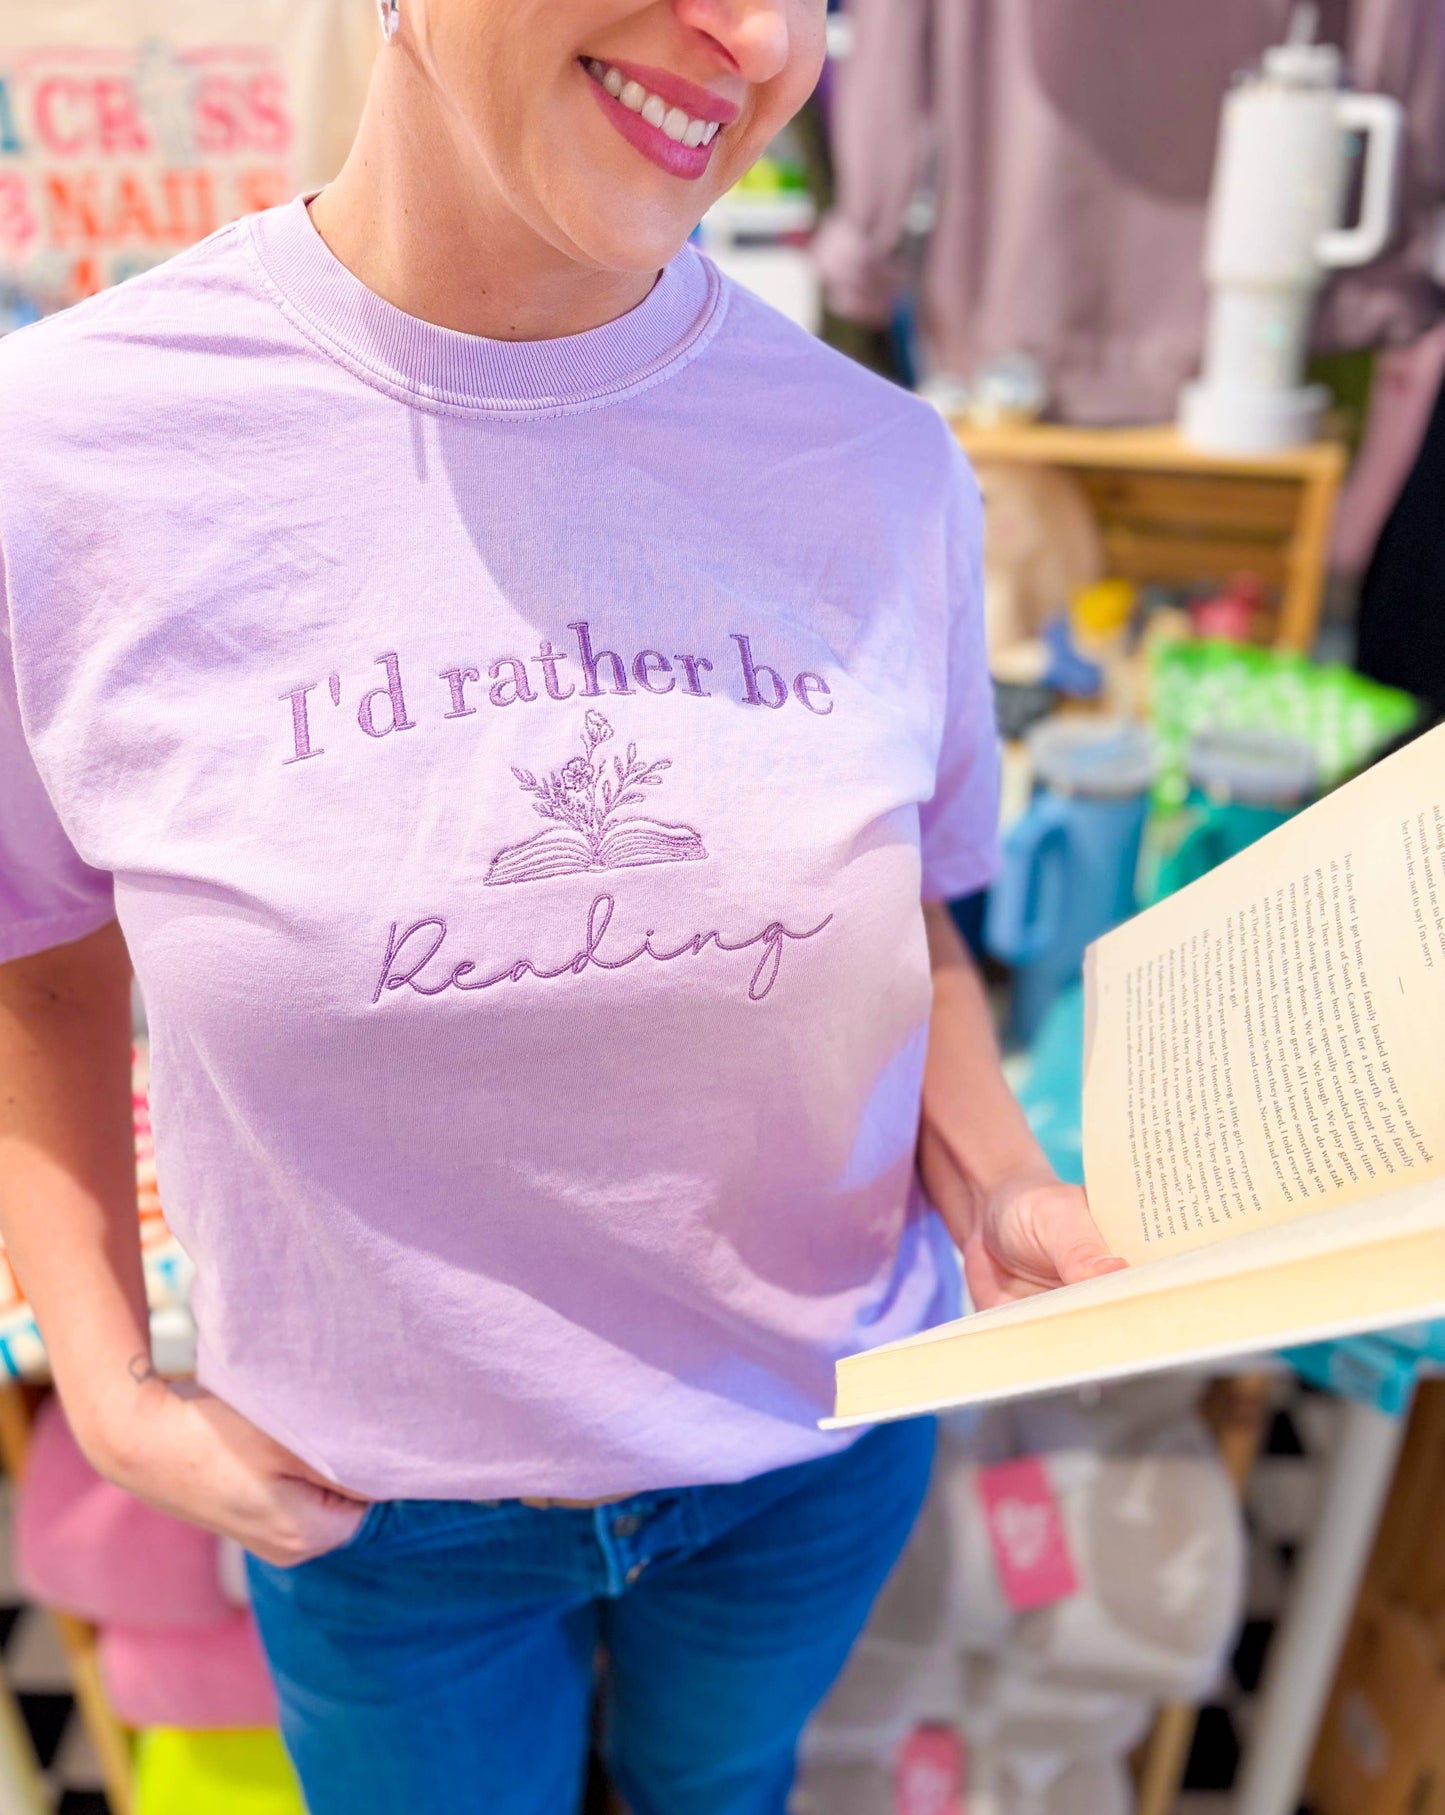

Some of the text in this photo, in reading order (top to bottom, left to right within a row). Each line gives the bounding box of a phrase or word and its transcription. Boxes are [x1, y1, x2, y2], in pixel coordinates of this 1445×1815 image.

[278, 621, 834, 765] I'd rather be
[1432, 804, 1443, 821] and
[1407, 860, 1415, 880] her,
[1410, 880, 1419, 897] not
[1430, 890, 1437, 906] me
[1412, 895, 1420, 908] to
[1433, 905, 1440, 918] to
[1414, 908, 1422, 924] say
[1435, 917, 1444, 932] be
[1418, 923, 1427, 941] I'm
[371, 893, 834, 1003] Reading
[1340, 950, 1349, 961] of
[1354, 939, 1364, 970] home,
[1422, 942, 1433, 969] sorry.
[1281, 976, 1290, 996] year
[1312, 970, 1323, 1002] family
[1328, 973, 1336, 997] have
[1342, 961, 1354, 991] South
[1359, 971, 1368, 988] our
[1258, 1001, 1266, 1020] this
[1285, 996, 1296, 1025] wasn't
[1296, 983, 1308, 1018] phones.
[1332, 996, 1341, 1021] been
[1347, 990, 1361, 1035] Carolina
[1363, 989, 1377, 1023] family
[1271, 993, 1281, 1035] Everyone
[1316, 1001, 1325, 1027] time,
[1259, 1019, 1267, 1039] way.
[1289, 1024, 1296, 1037] so
[1304, 1020, 1314, 1036] We
[1337, 1023, 1346, 1033] at
[1262, 1038, 1270, 1052] So
[1277, 1035, 1284, 1046] in
[1289, 1037, 1302, 1063] great.
[1307, 1036, 1319, 1060] talk.
[1321, 1027, 1338, 1074] especially
[1339, 1034, 1352, 1058] least
[1357, 1035, 1366, 1051] for
[1371, 1023, 1389, 1058] loaded
[1264, 1052, 1274, 1078] when
[1278, 1047, 1286, 1064] my
[1312, 1058, 1322, 1077] We
[1382, 1060, 1392, 1075] up
[1281, 1062, 1293, 1095] family
[1296, 1062, 1307, 1080] All
[1346, 1059, 1358, 1086] forty
[1365, 1062, 1384, 1098] Fourth
[1224, 1067, 1233, 1100] having
[1269, 1077, 1278, 1100] they
[1316, 1077, 1331, 1107] laugh.
[1387, 1076, 1399, 1095] our
[1243, 1004, 1292, 1203] supportive and curious. No one had ever seen
[1288, 1094, 1299, 1122] knew
[1302, 1087, 1319, 1122] wanted
[1332, 1074, 1354, 1119] extended
[1377, 1100, 1389, 1112] of
[1396, 1098, 1409, 1117] van
[1230, 1106, 1240, 1128] little
[1273, 1098, 1286, 1128] asked,
[1326, 1110, 1337, 1127] We
[1354, 1087, 1377, 1131] different
[1312, 1123, 1320, 1134] to
[1347, 1120, 1364, 1153] family
[1381, 1114, 1396, 1136] July
[1405, 1119, 1421, 1139] and
[1232, 1129, 1244, 1148] girl,
[1282, 1135, 1295, 1155] told
[1295, 1123, 1317, 1175] something
[1316, 1134, 1325, 1149] do
[1329, 1129, 1344, 1150] play
[1216, 1106, 1245, 1215] if I'd been in their posi-
[1321, 1150, 1333, 1169] was
[1371, 1134, 1395, 1174] relatives
[1392, 1136, 1412, 1169] family
[1415, 1140, 1434, 1163] took
[1239, 1150, 1254, 1192] everyone
[1288, 1155, 1308, 1198] everyone
[1338, 1151, 1357, 1183] games.
[1360, 1154, 1375, 1179] time,
[1208, 1139, 1231, 1220] They didn't know
[1313, 1175, 1325, 1194] was
[1329, 1169, 1344, 1189] talk
[1159, 1172, 1175, 1236] defensive over
[1198, 1161, 1218, 1224] nineteen, and
[1251, 1193, 1261, 1212] was
[1137, 1191, 1150, 1243] The answer
[1179, 1205, 1189, 1232] know
